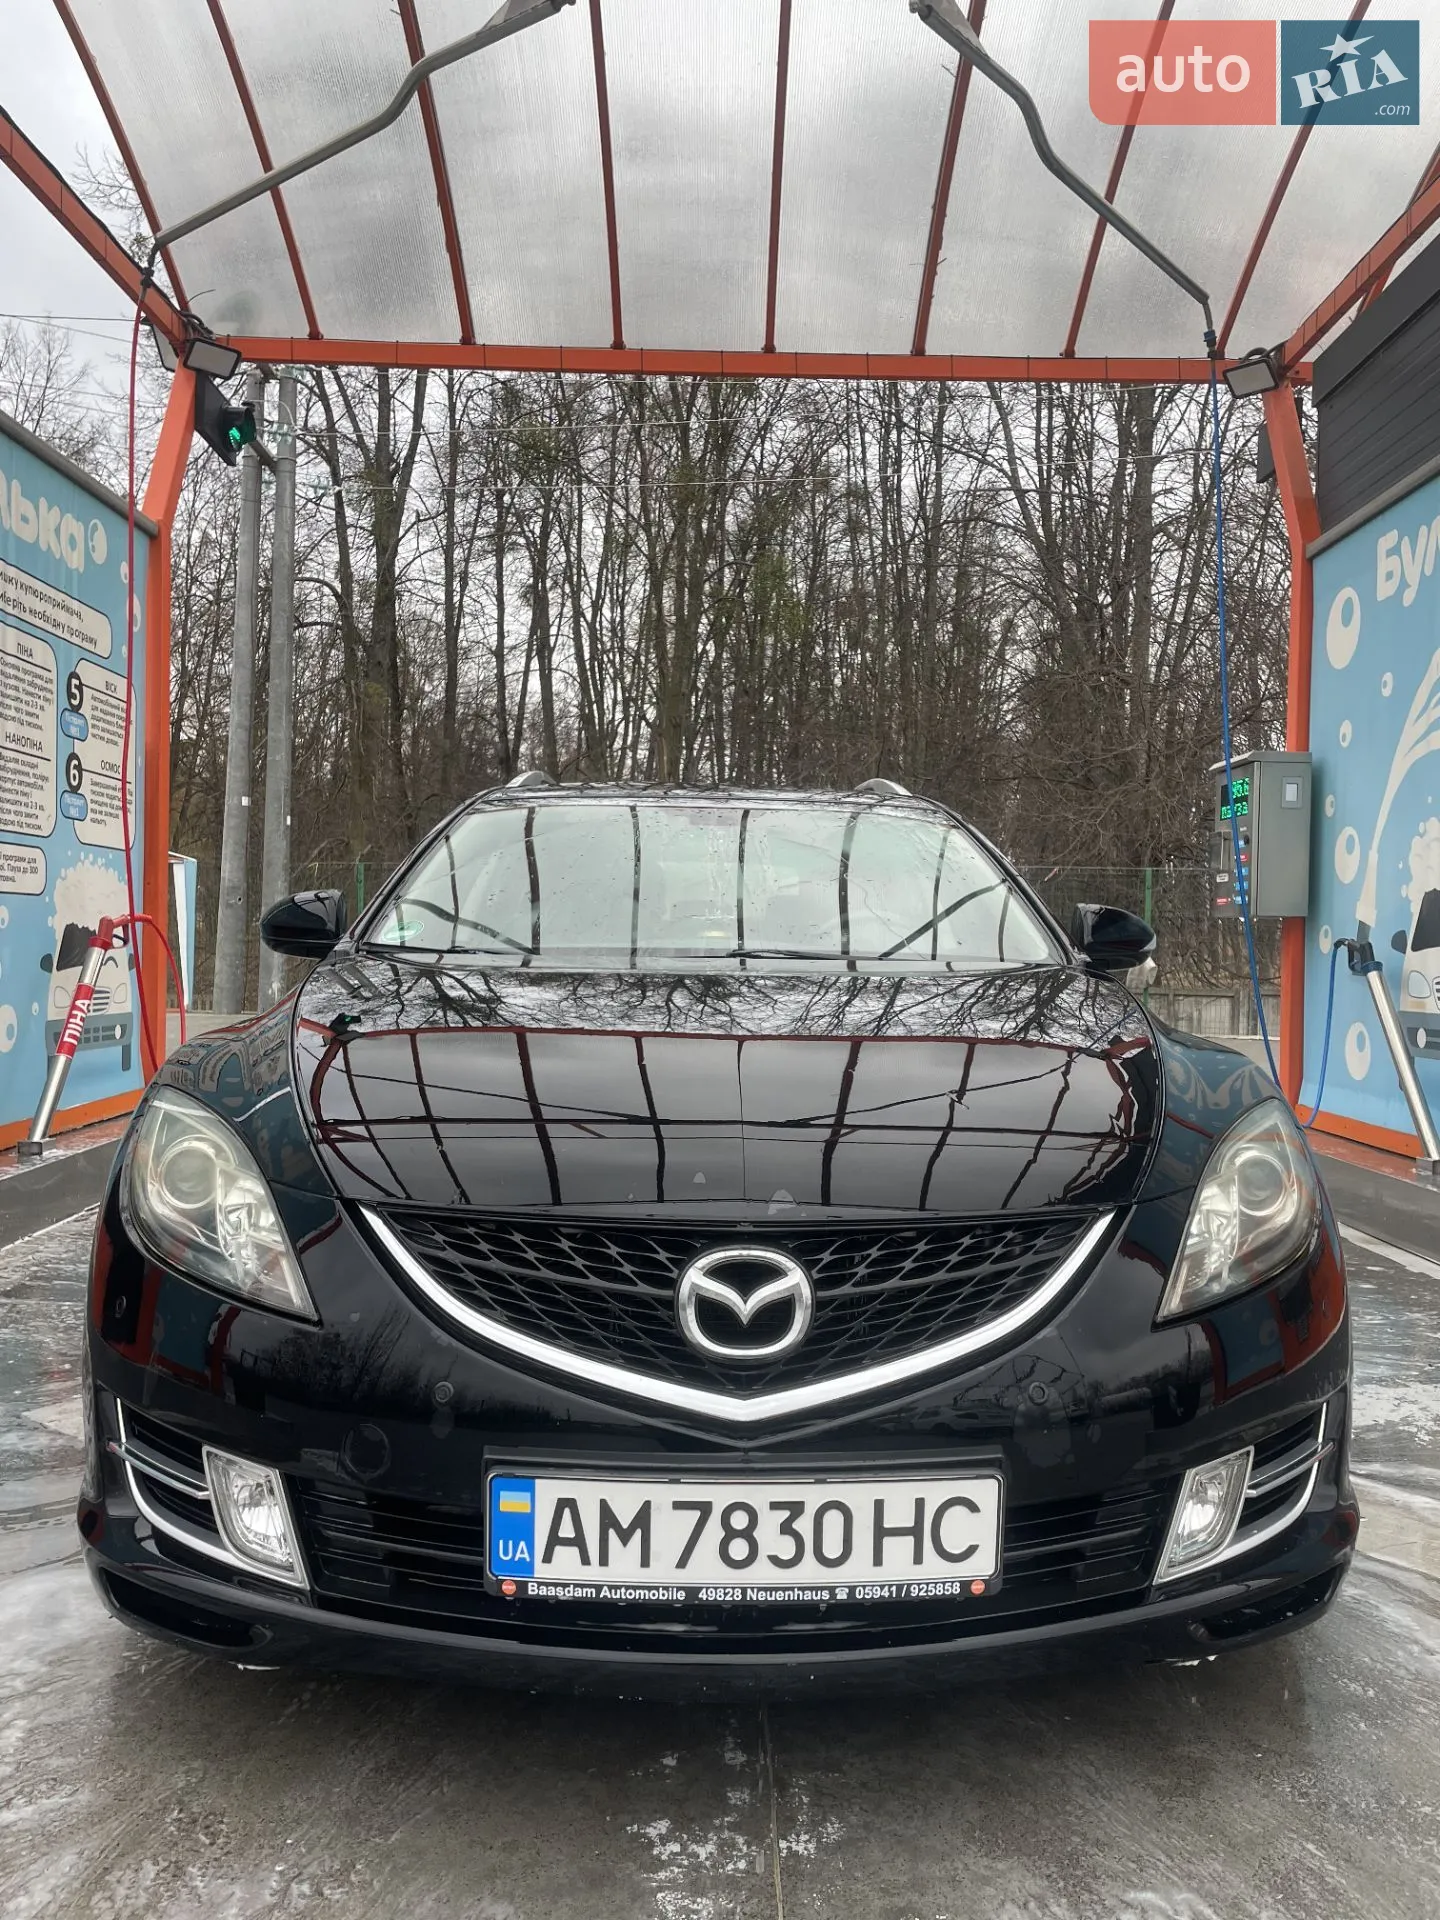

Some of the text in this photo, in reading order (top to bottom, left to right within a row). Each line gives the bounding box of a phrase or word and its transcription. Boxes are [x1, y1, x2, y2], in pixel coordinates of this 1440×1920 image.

[67, 625, 98, 651] програму
[17, 642, 33, 659] ПІНА
[70, 678, 80, 706] 5
[105, 680, 118, 694] ВІСК
[6, 731, 42, 752] НАНОПІНА
[70, 760, 79, 786] 6
[63, 1000, 90, 1046] ПІНА
[542, 1496, 981, 1570] AM 7830 HC
[499, 1540, 530, 1562] UA
[528, 1582, 596, 1598] Baasdam
[600, 1586, 686, 1600] Automobile
[698, 1587, 742, 1600] 49828
[747, 1588, 829, 1600] Neuenhaus
[856, 1586, 897, 1599] 05941
[902, 1585, 908, 1598] /
[910, 1582, 960, 1597] 925858
